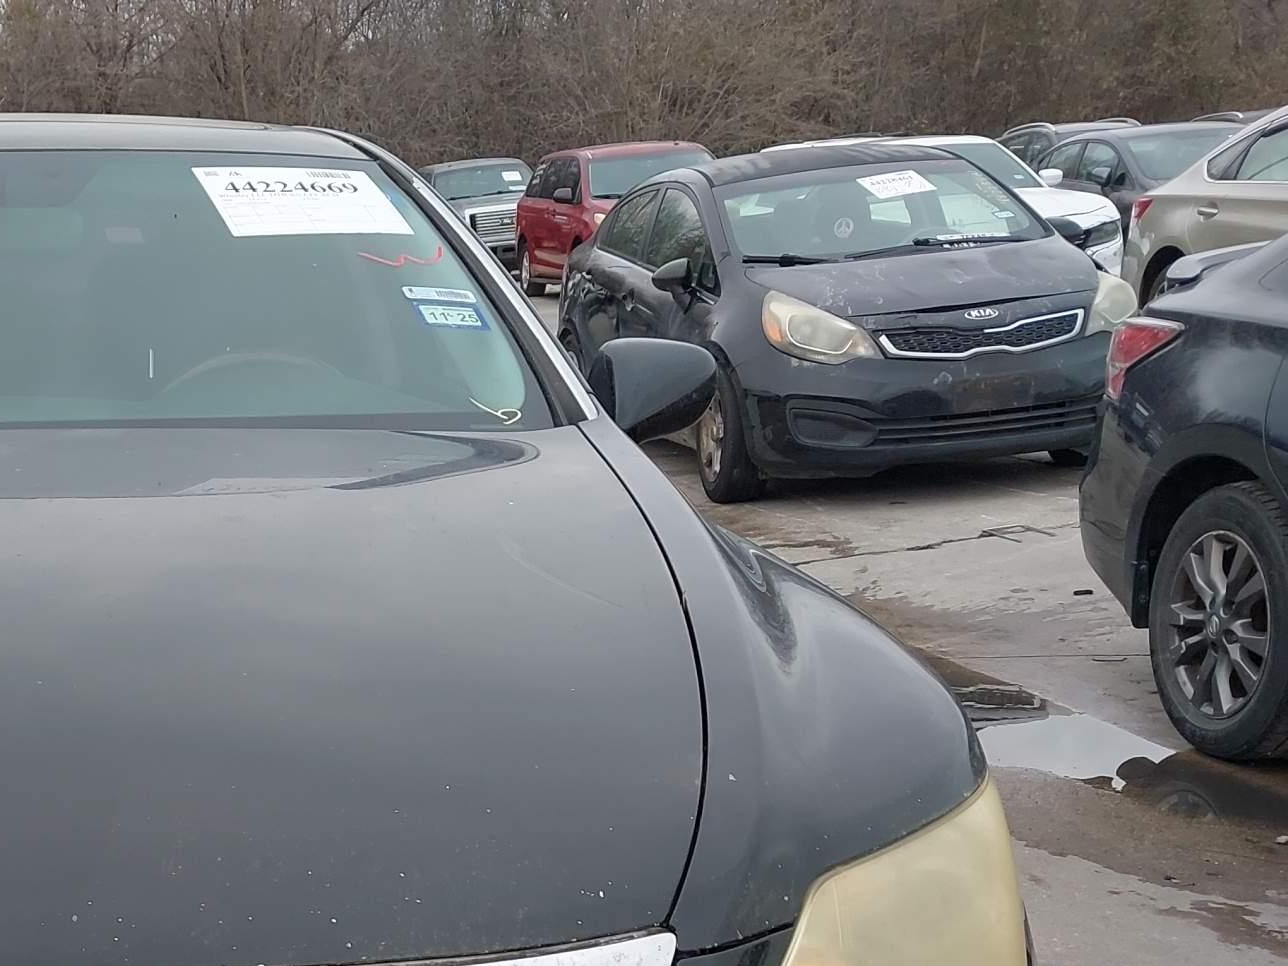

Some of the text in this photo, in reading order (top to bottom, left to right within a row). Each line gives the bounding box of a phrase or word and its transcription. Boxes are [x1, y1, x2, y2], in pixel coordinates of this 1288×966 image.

[224, 181, 359, 194] 44224669
[429, 311, 479, 323] 11 25
[969, 308, 995, 318] KIA
